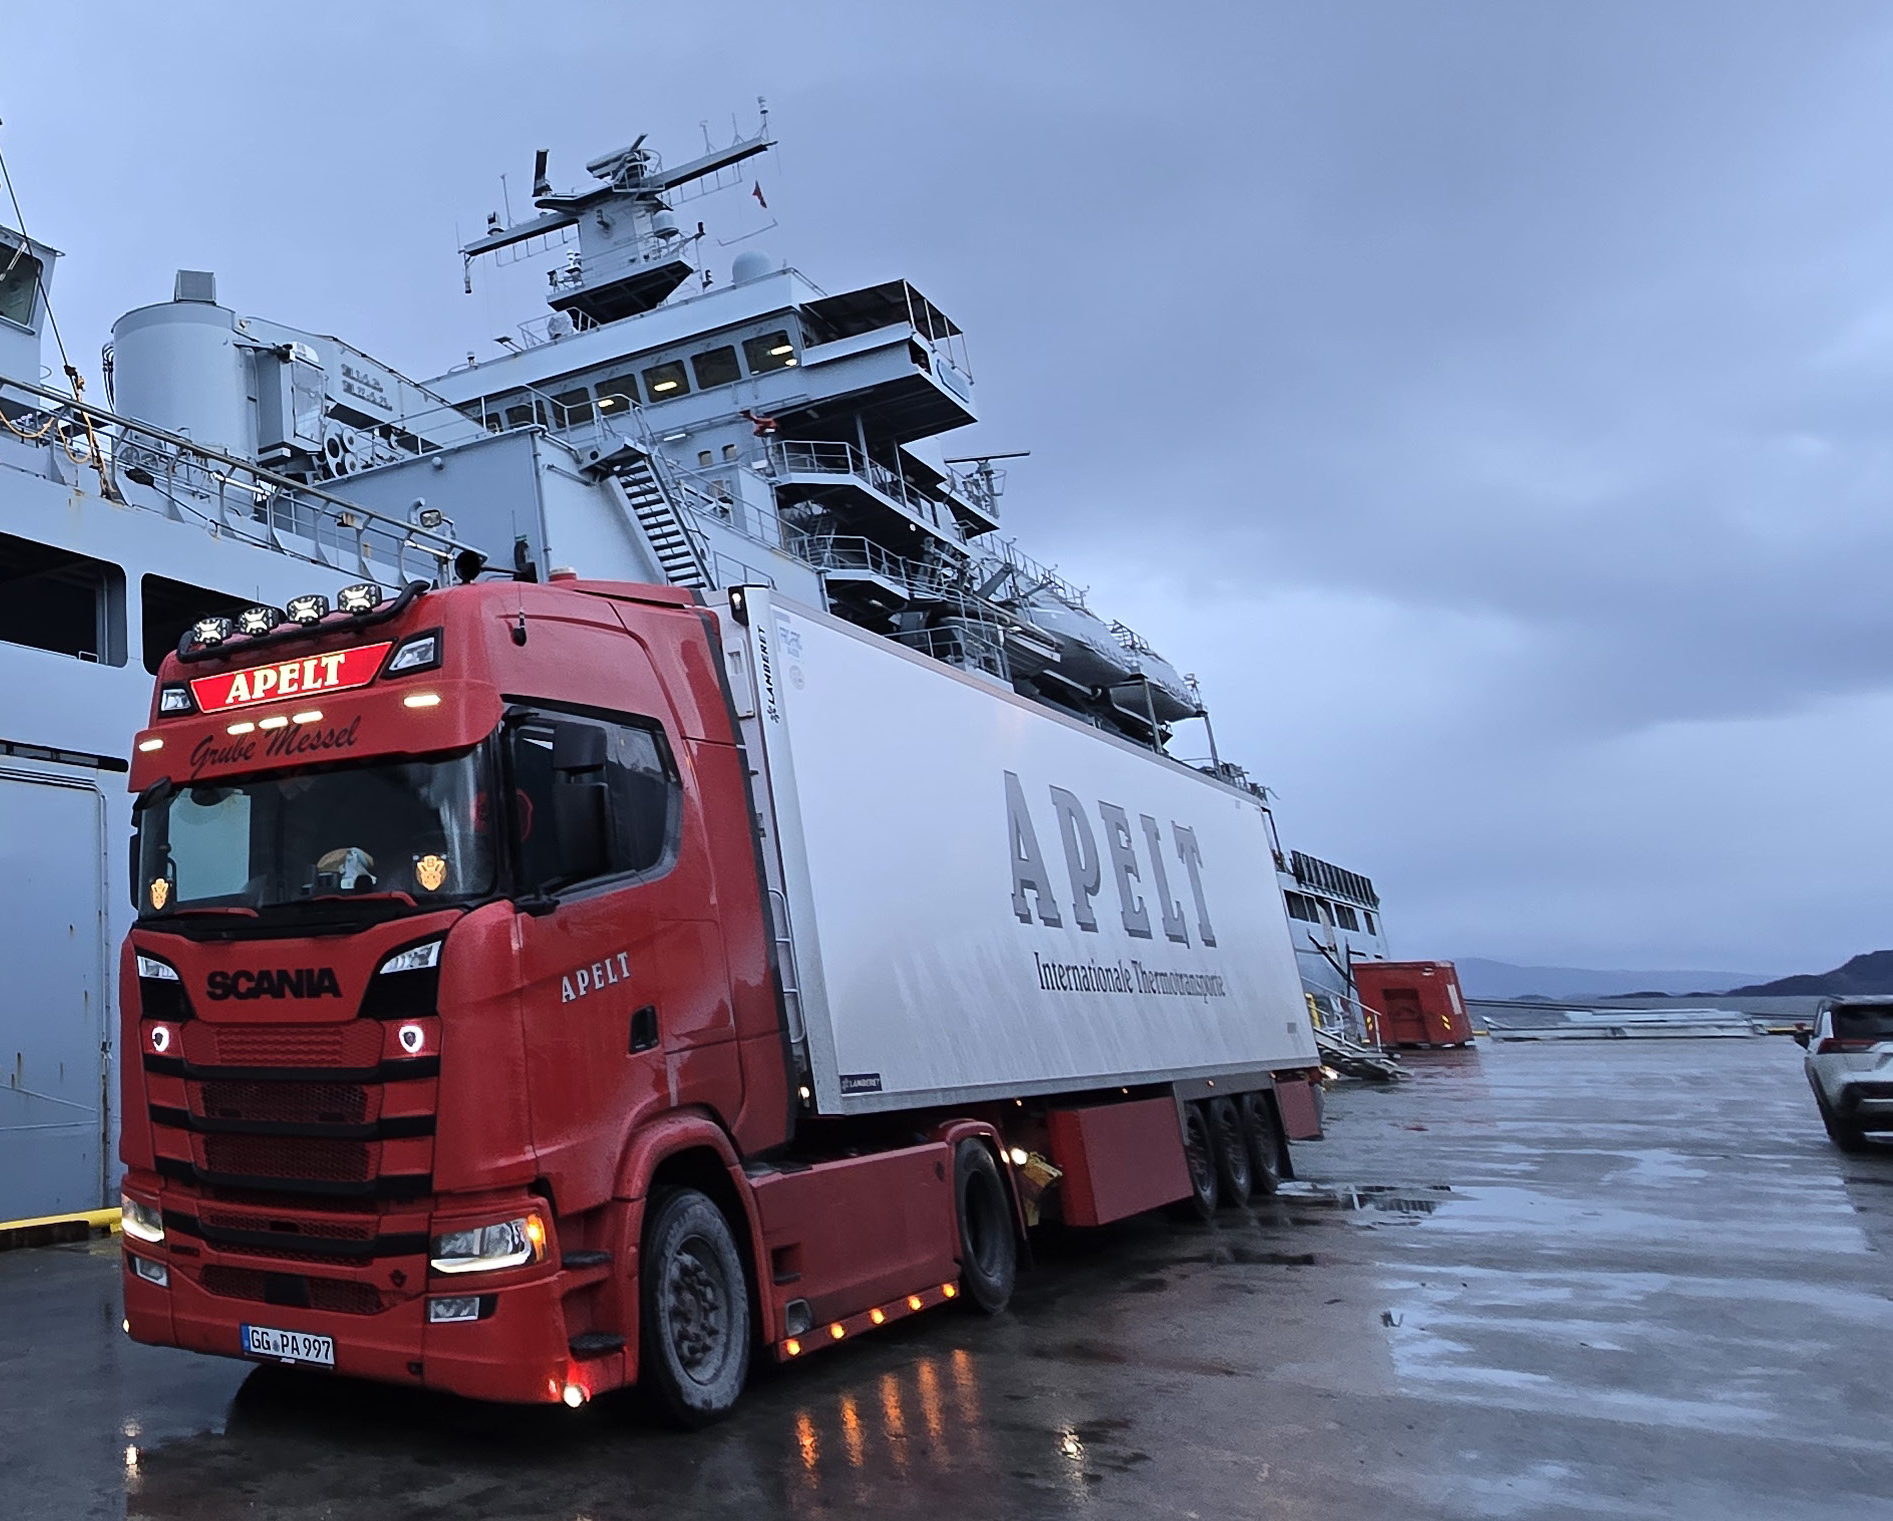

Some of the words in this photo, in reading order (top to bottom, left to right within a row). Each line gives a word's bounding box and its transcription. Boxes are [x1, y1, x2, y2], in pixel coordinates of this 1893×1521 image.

[225, 654, 345, 704] APELT
[757, 625, 776, 705] LAMBERET
[190, 732, 256, 780] Grube
[264, 714, 362, 757] Messel
[1004, 770, 1217, 949] APELT
[206, 967, 343, 1000] SCANIA
[561, 951, 631, 1003] APELT
[1034, 951, 1134, 994] Internationale
[1131, 959, 1227, 1005] Thermotransporte
[251, 1329, 271, 1351] GG
